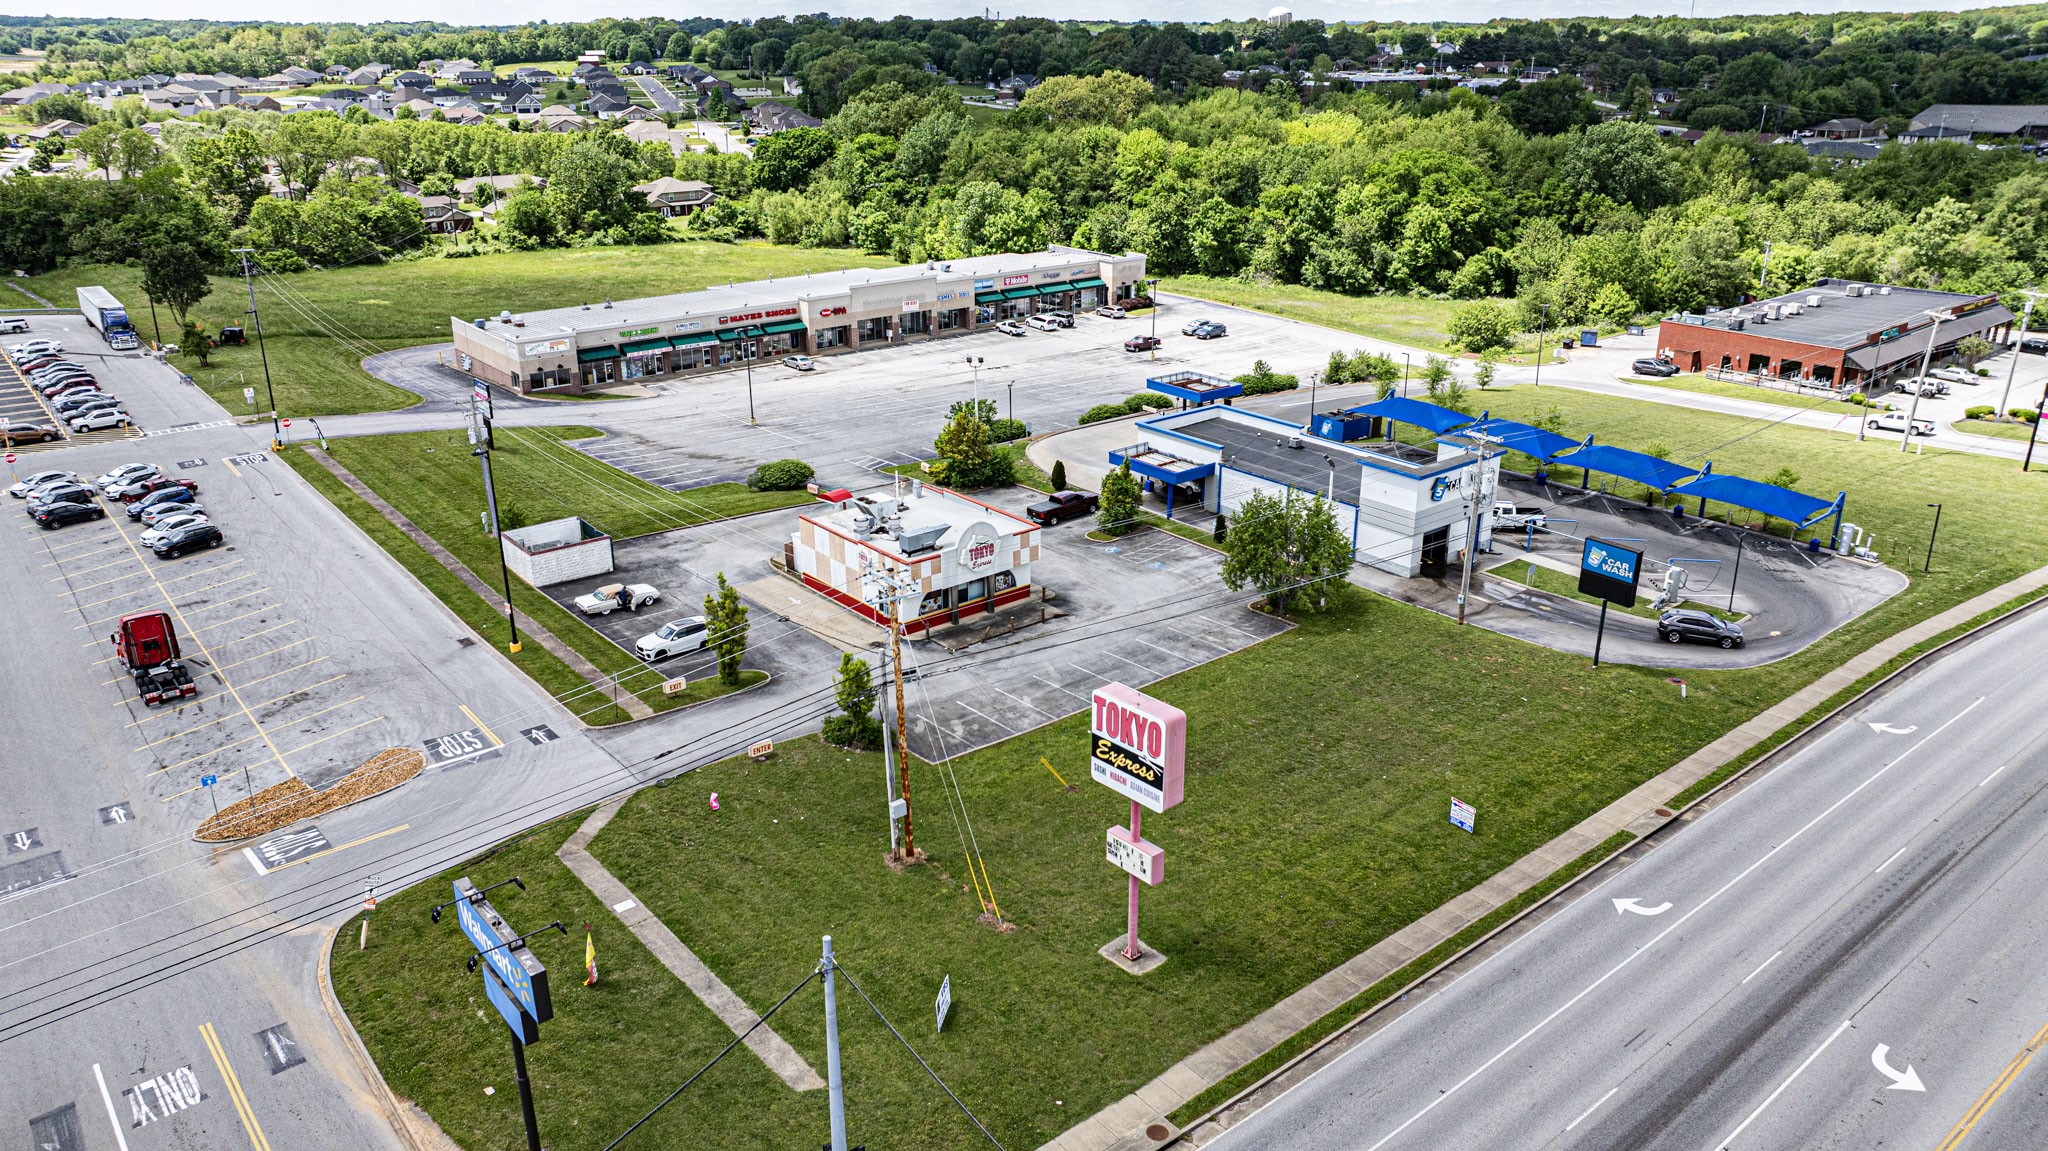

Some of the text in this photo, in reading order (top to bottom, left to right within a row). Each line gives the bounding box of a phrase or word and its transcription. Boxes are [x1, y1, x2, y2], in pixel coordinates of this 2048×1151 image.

[730, 308, 797, 322] HAYES SHOES
[833, 306, 847, 315] SPA
[236, 453, 264, 465] STOP
[1435, 487, 1443, 497] 5
[969, 543, 994, 561] TOKYO
[972, 560, 992, 569] Express
[1602, 563, 1633, 579] WASH
[1607, 559, 1629, 570] CAR
[669, 682, 682, 692] EXIT
[1094, 695, 1162, 759] TOKYO
[436, 730, 483, 757] STOP
[752, 743, 772, 755] ENTER
[1096, 739, 1155, 781] Express
[1094, 763, 1161, 803] SUSHI HIBACHI ASIAN CUISINE
[459, 900, 514, 984] Walmart
[129, 1067, 201, 1126] ONLY
